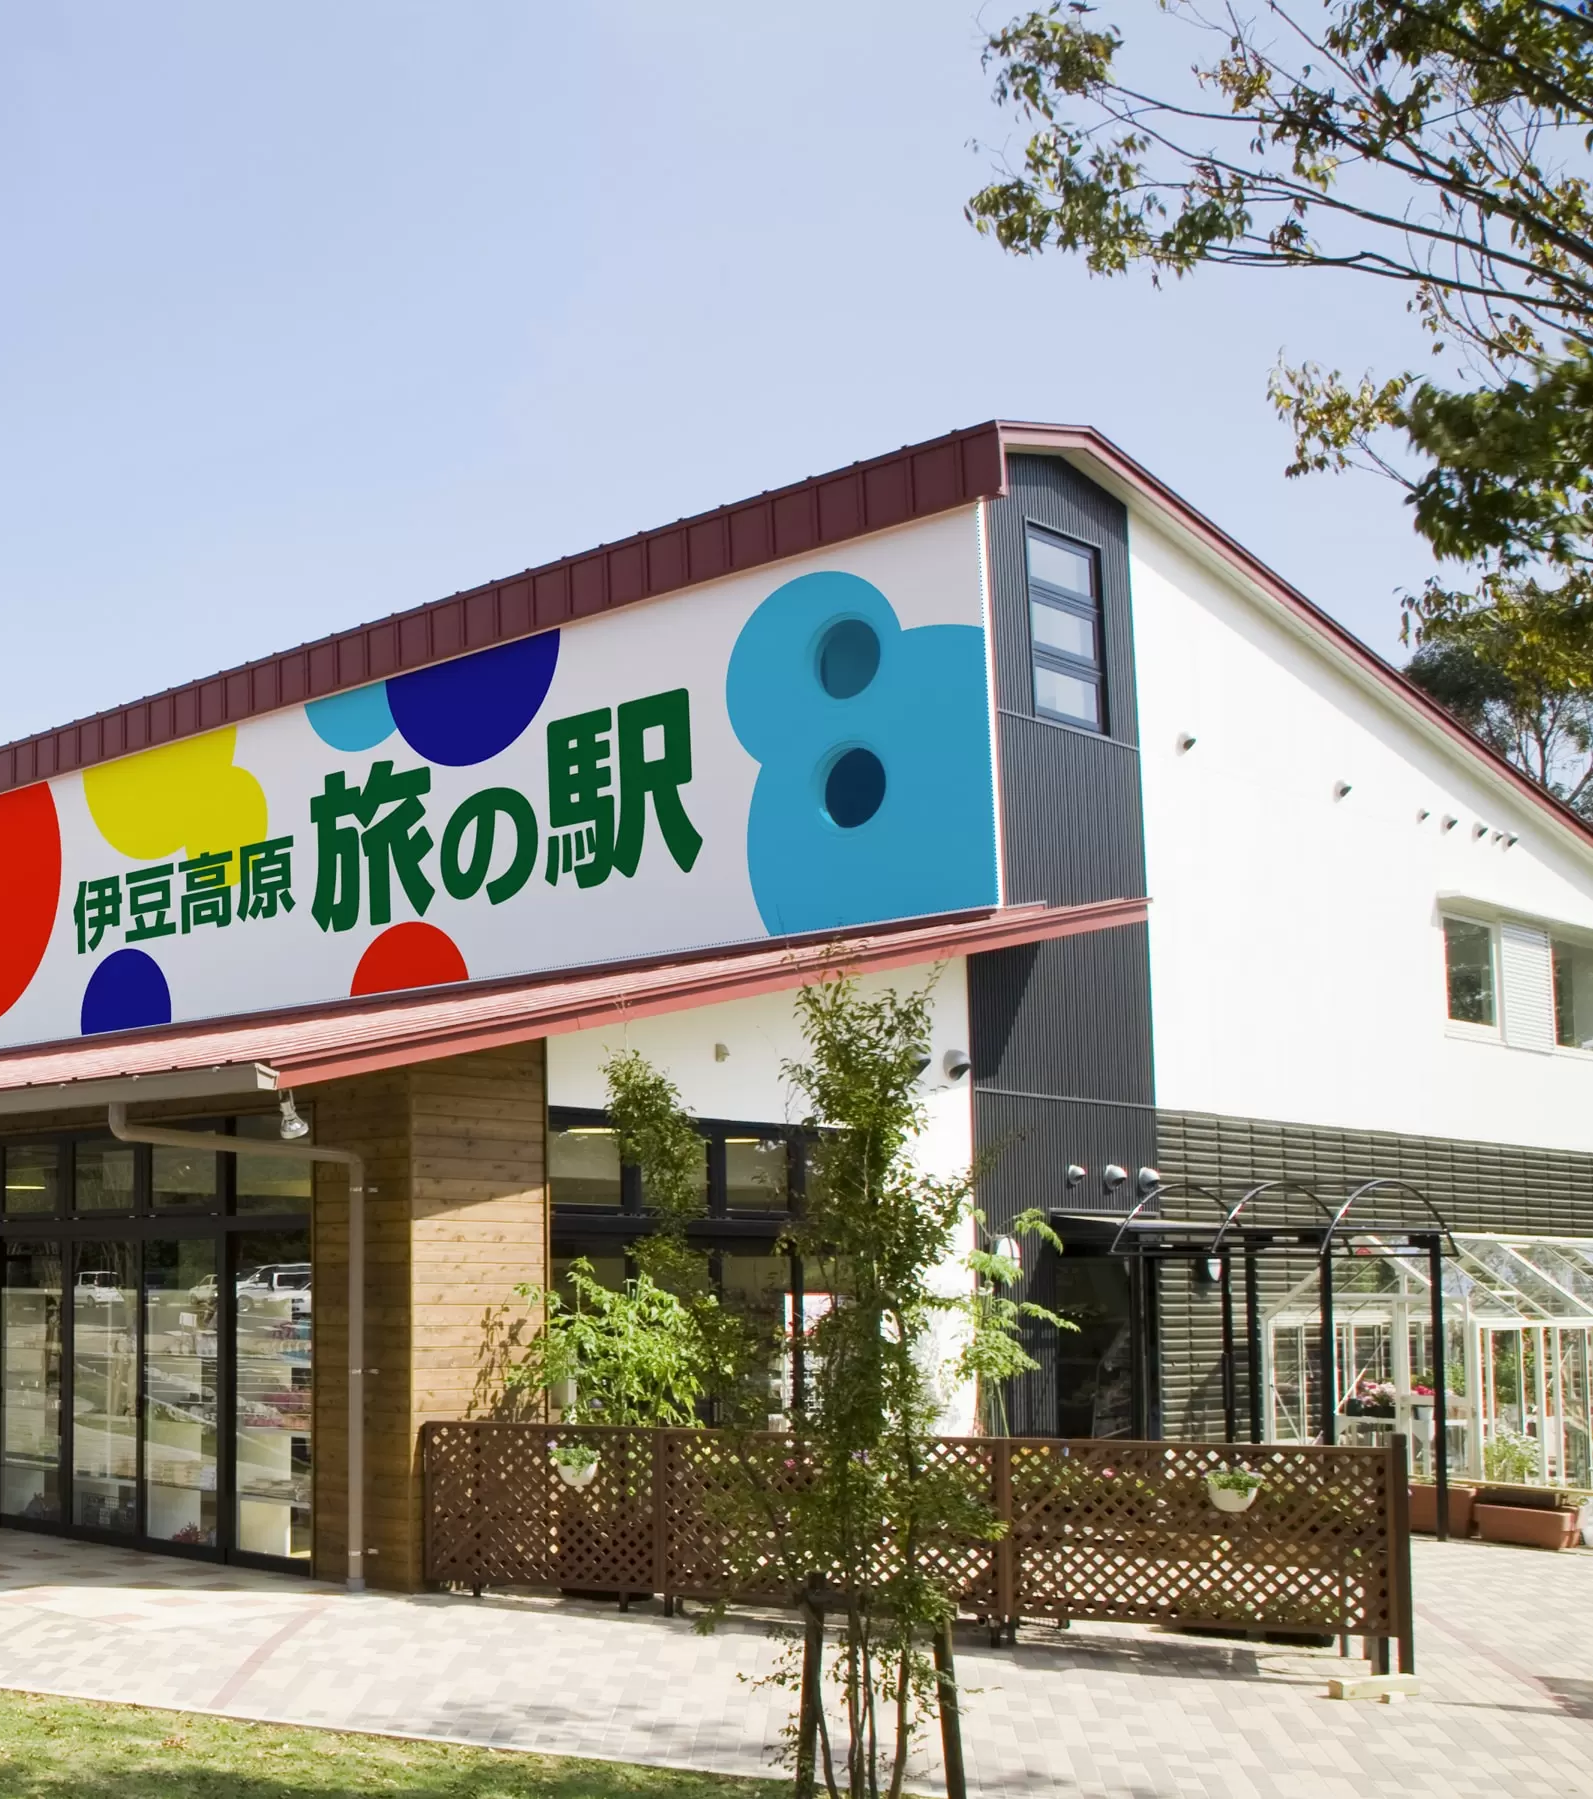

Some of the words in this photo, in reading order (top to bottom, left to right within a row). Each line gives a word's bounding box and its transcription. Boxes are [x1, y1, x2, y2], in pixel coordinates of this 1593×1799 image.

[73, 835, 296, 954] 伊豆高原
[310, 688, 703, 934] 旅の駅
